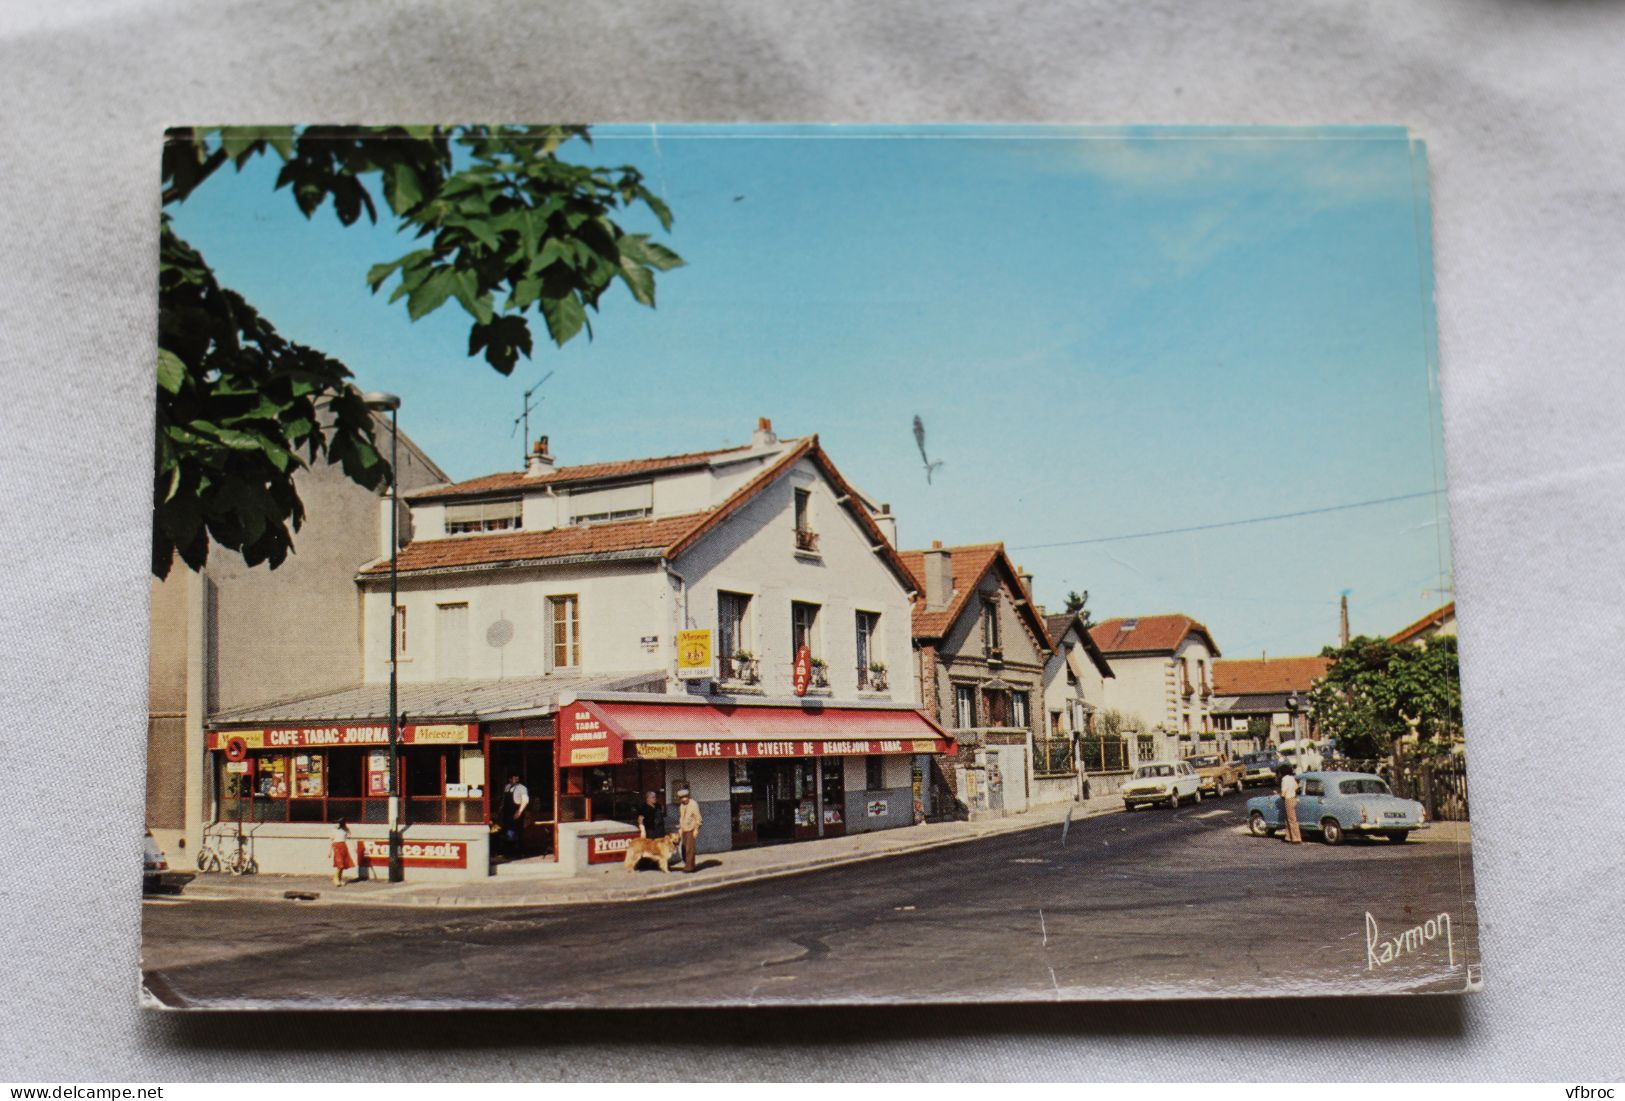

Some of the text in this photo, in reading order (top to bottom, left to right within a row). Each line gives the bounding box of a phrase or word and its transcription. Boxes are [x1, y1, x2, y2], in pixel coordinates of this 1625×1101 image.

[796, 650, 806, 692] TABAC
[575, 711, 591, 720] BAR
[575, 721, 600, 730] TABAC
[270, 730, 299, 745] CAFE
[304, 728, 340, 744] TABAC
[344, 726, 406, 742] JOURNAX
[695, 742, 721, 756] CAFE
[735, 742, 748, 755] LA
[757, 742, 795, 755] CIVETTE
[802, 741, 814, 754] DE
[822, 741, 870, 754] BEAUSEJOUR
[879, 740, 902, 752] TABAC
[364, 841, 460, 857] Frace-soir
[1365, 911, 1454, 971] Raymon
